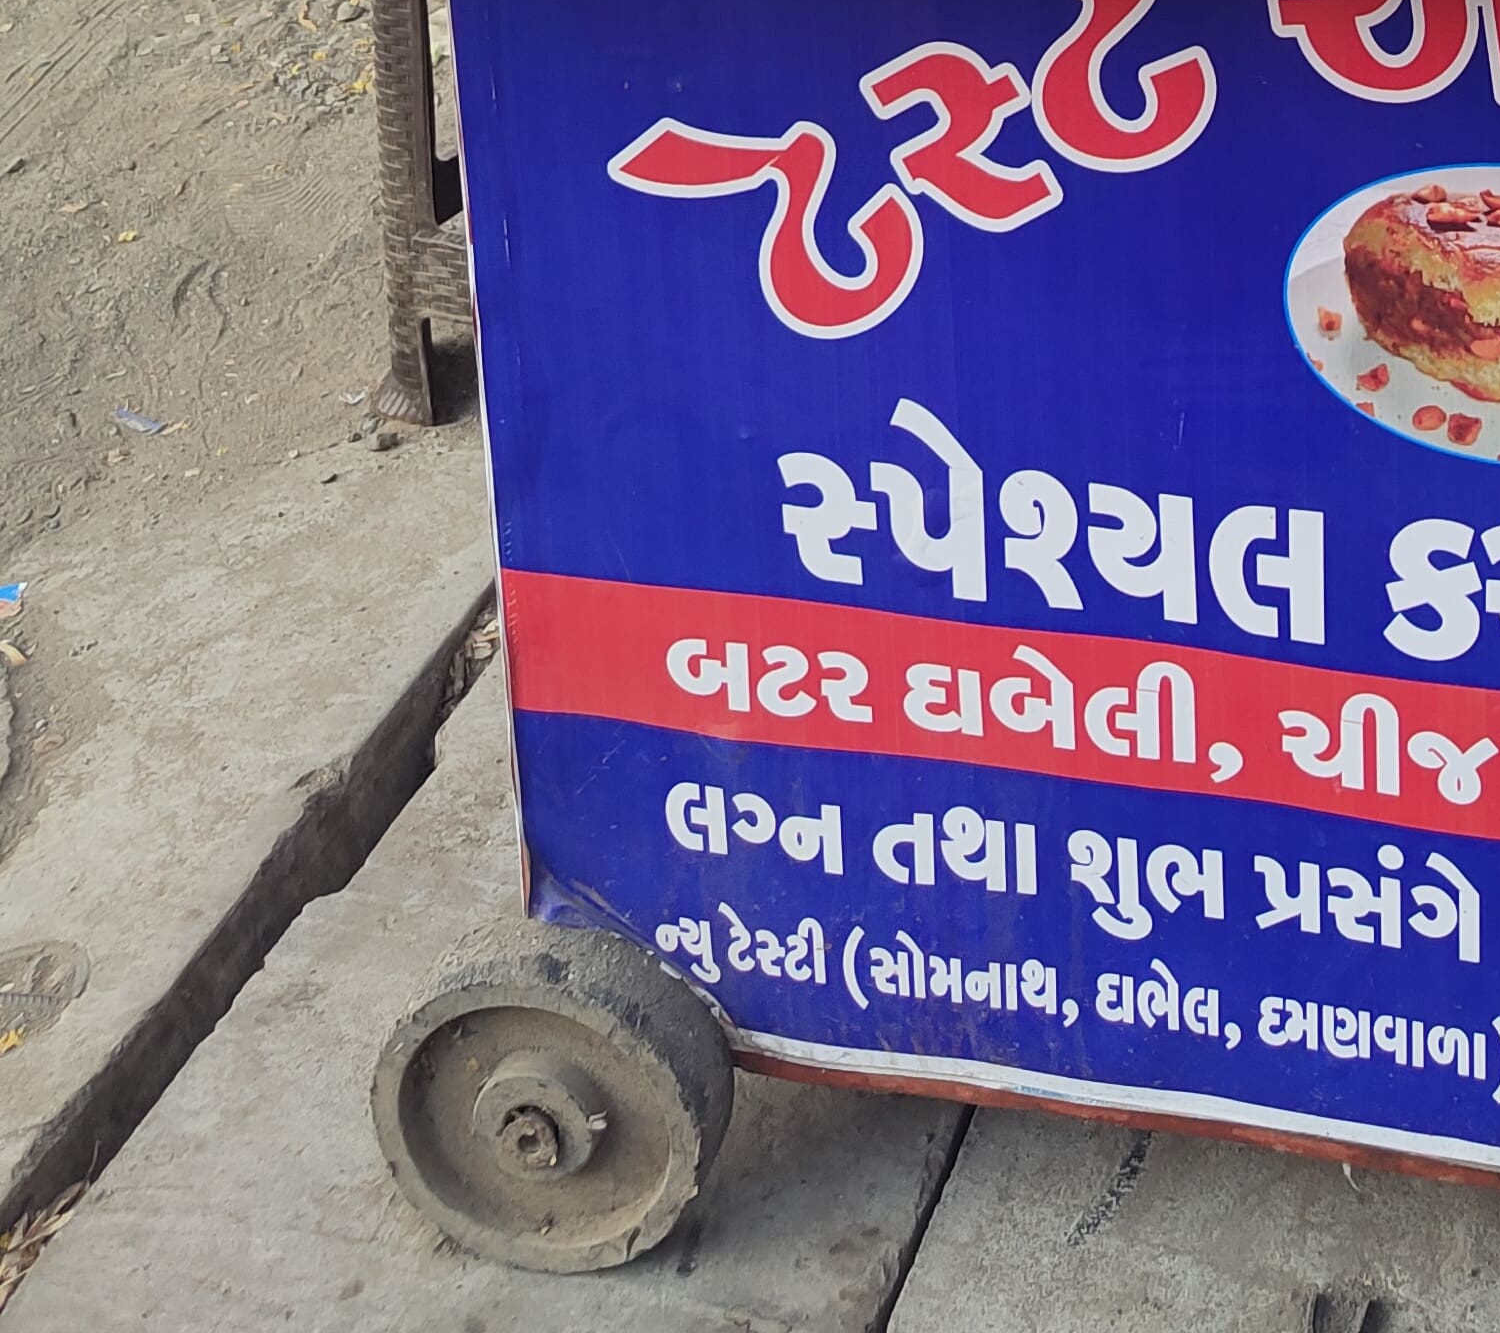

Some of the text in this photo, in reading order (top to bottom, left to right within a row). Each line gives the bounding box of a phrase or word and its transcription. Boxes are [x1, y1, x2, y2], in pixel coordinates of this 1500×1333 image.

[778, 398, 1325, 645] સ્પેશ્યલ
[665, 637, 873, 723] બટર
[903, 644, 1244, 783] દાબેલી,
[1278, 692, 1499, 806] ચીજ
[665, 782, 844, 876] લગ્ન
[872, 806, 1037, 896] તથા
[1067, 830, 1225, 941] શુભ
[1254, 844, 1480, 964] પ્રસંગે
[722, 902, 827, 985] ટેસ્ટી
[843, 925, 1080, 1028] (સોમનાથ,
